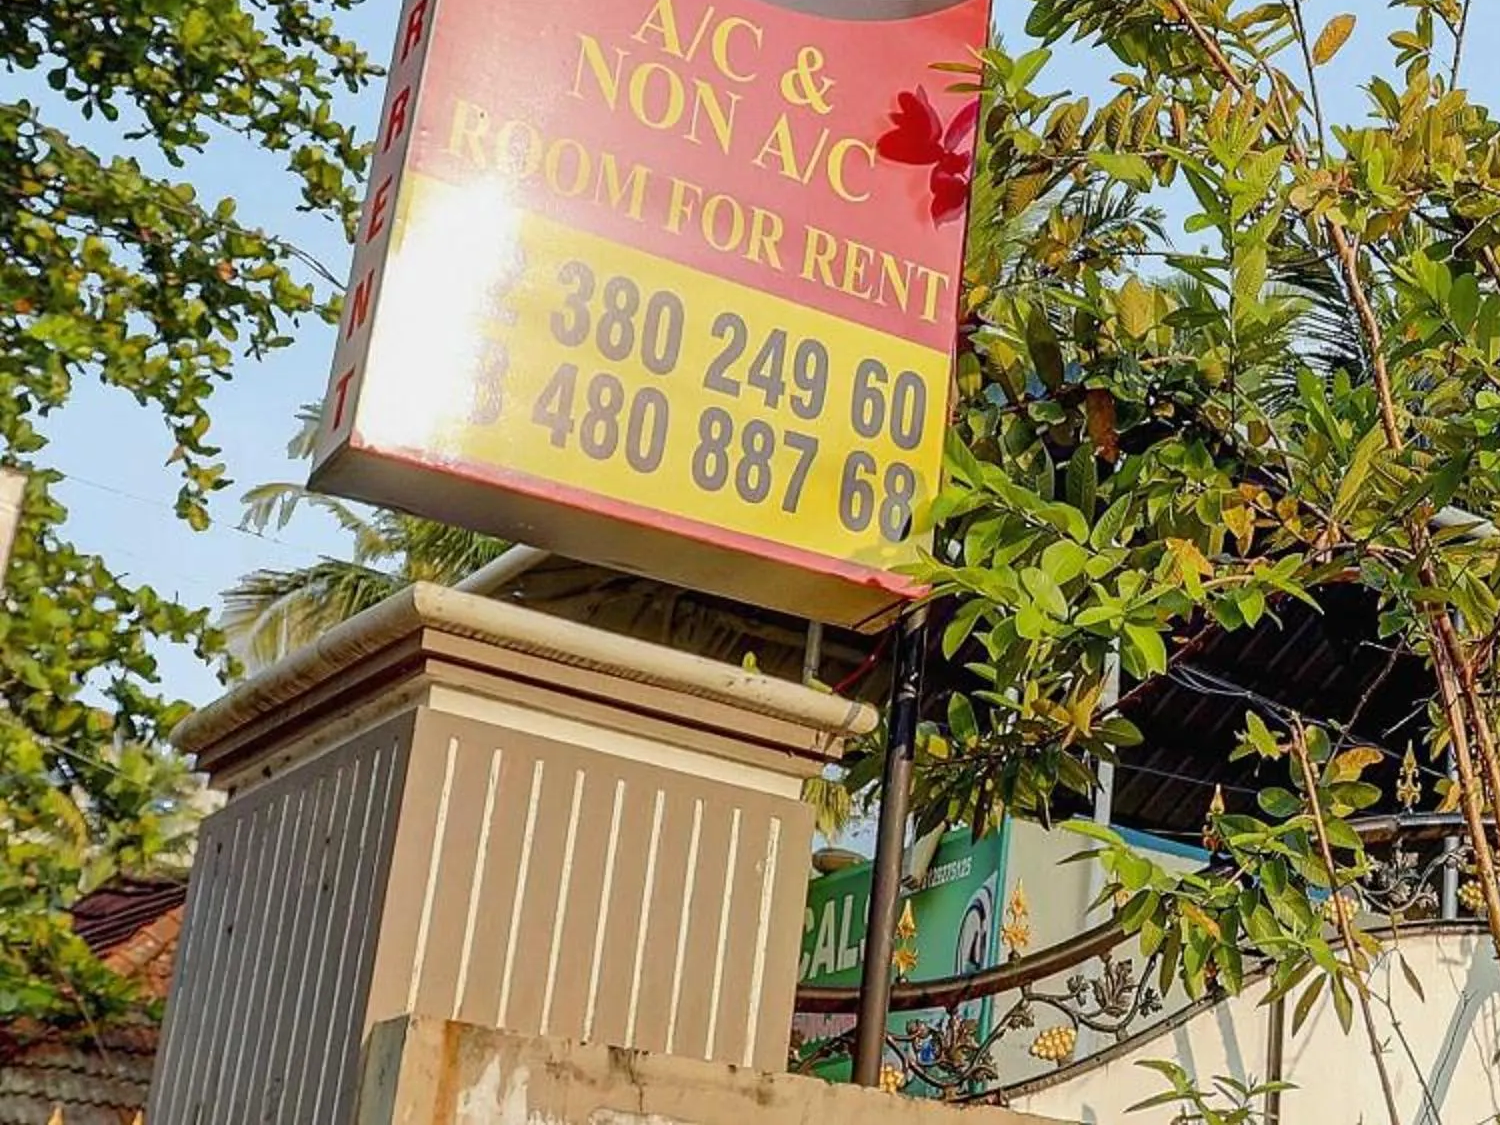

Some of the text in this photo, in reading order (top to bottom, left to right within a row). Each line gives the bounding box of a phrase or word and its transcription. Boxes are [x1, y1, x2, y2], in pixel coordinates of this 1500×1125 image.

[567, 34, 877, 203] NON A/C
[780, 46, 837, 116] &
[331, 85, 412, 432] RENT
[442, 100, 950, 324] ROOM FOR RENT
[550, 260, 685, 375] 380
[702, 311, 829, 420] 249
[850, 357, 927, 450] 60
[531, 363, 670, 474] 480
[691, 406, 818, 514] 887
[838, 449, 917, 544] 68
